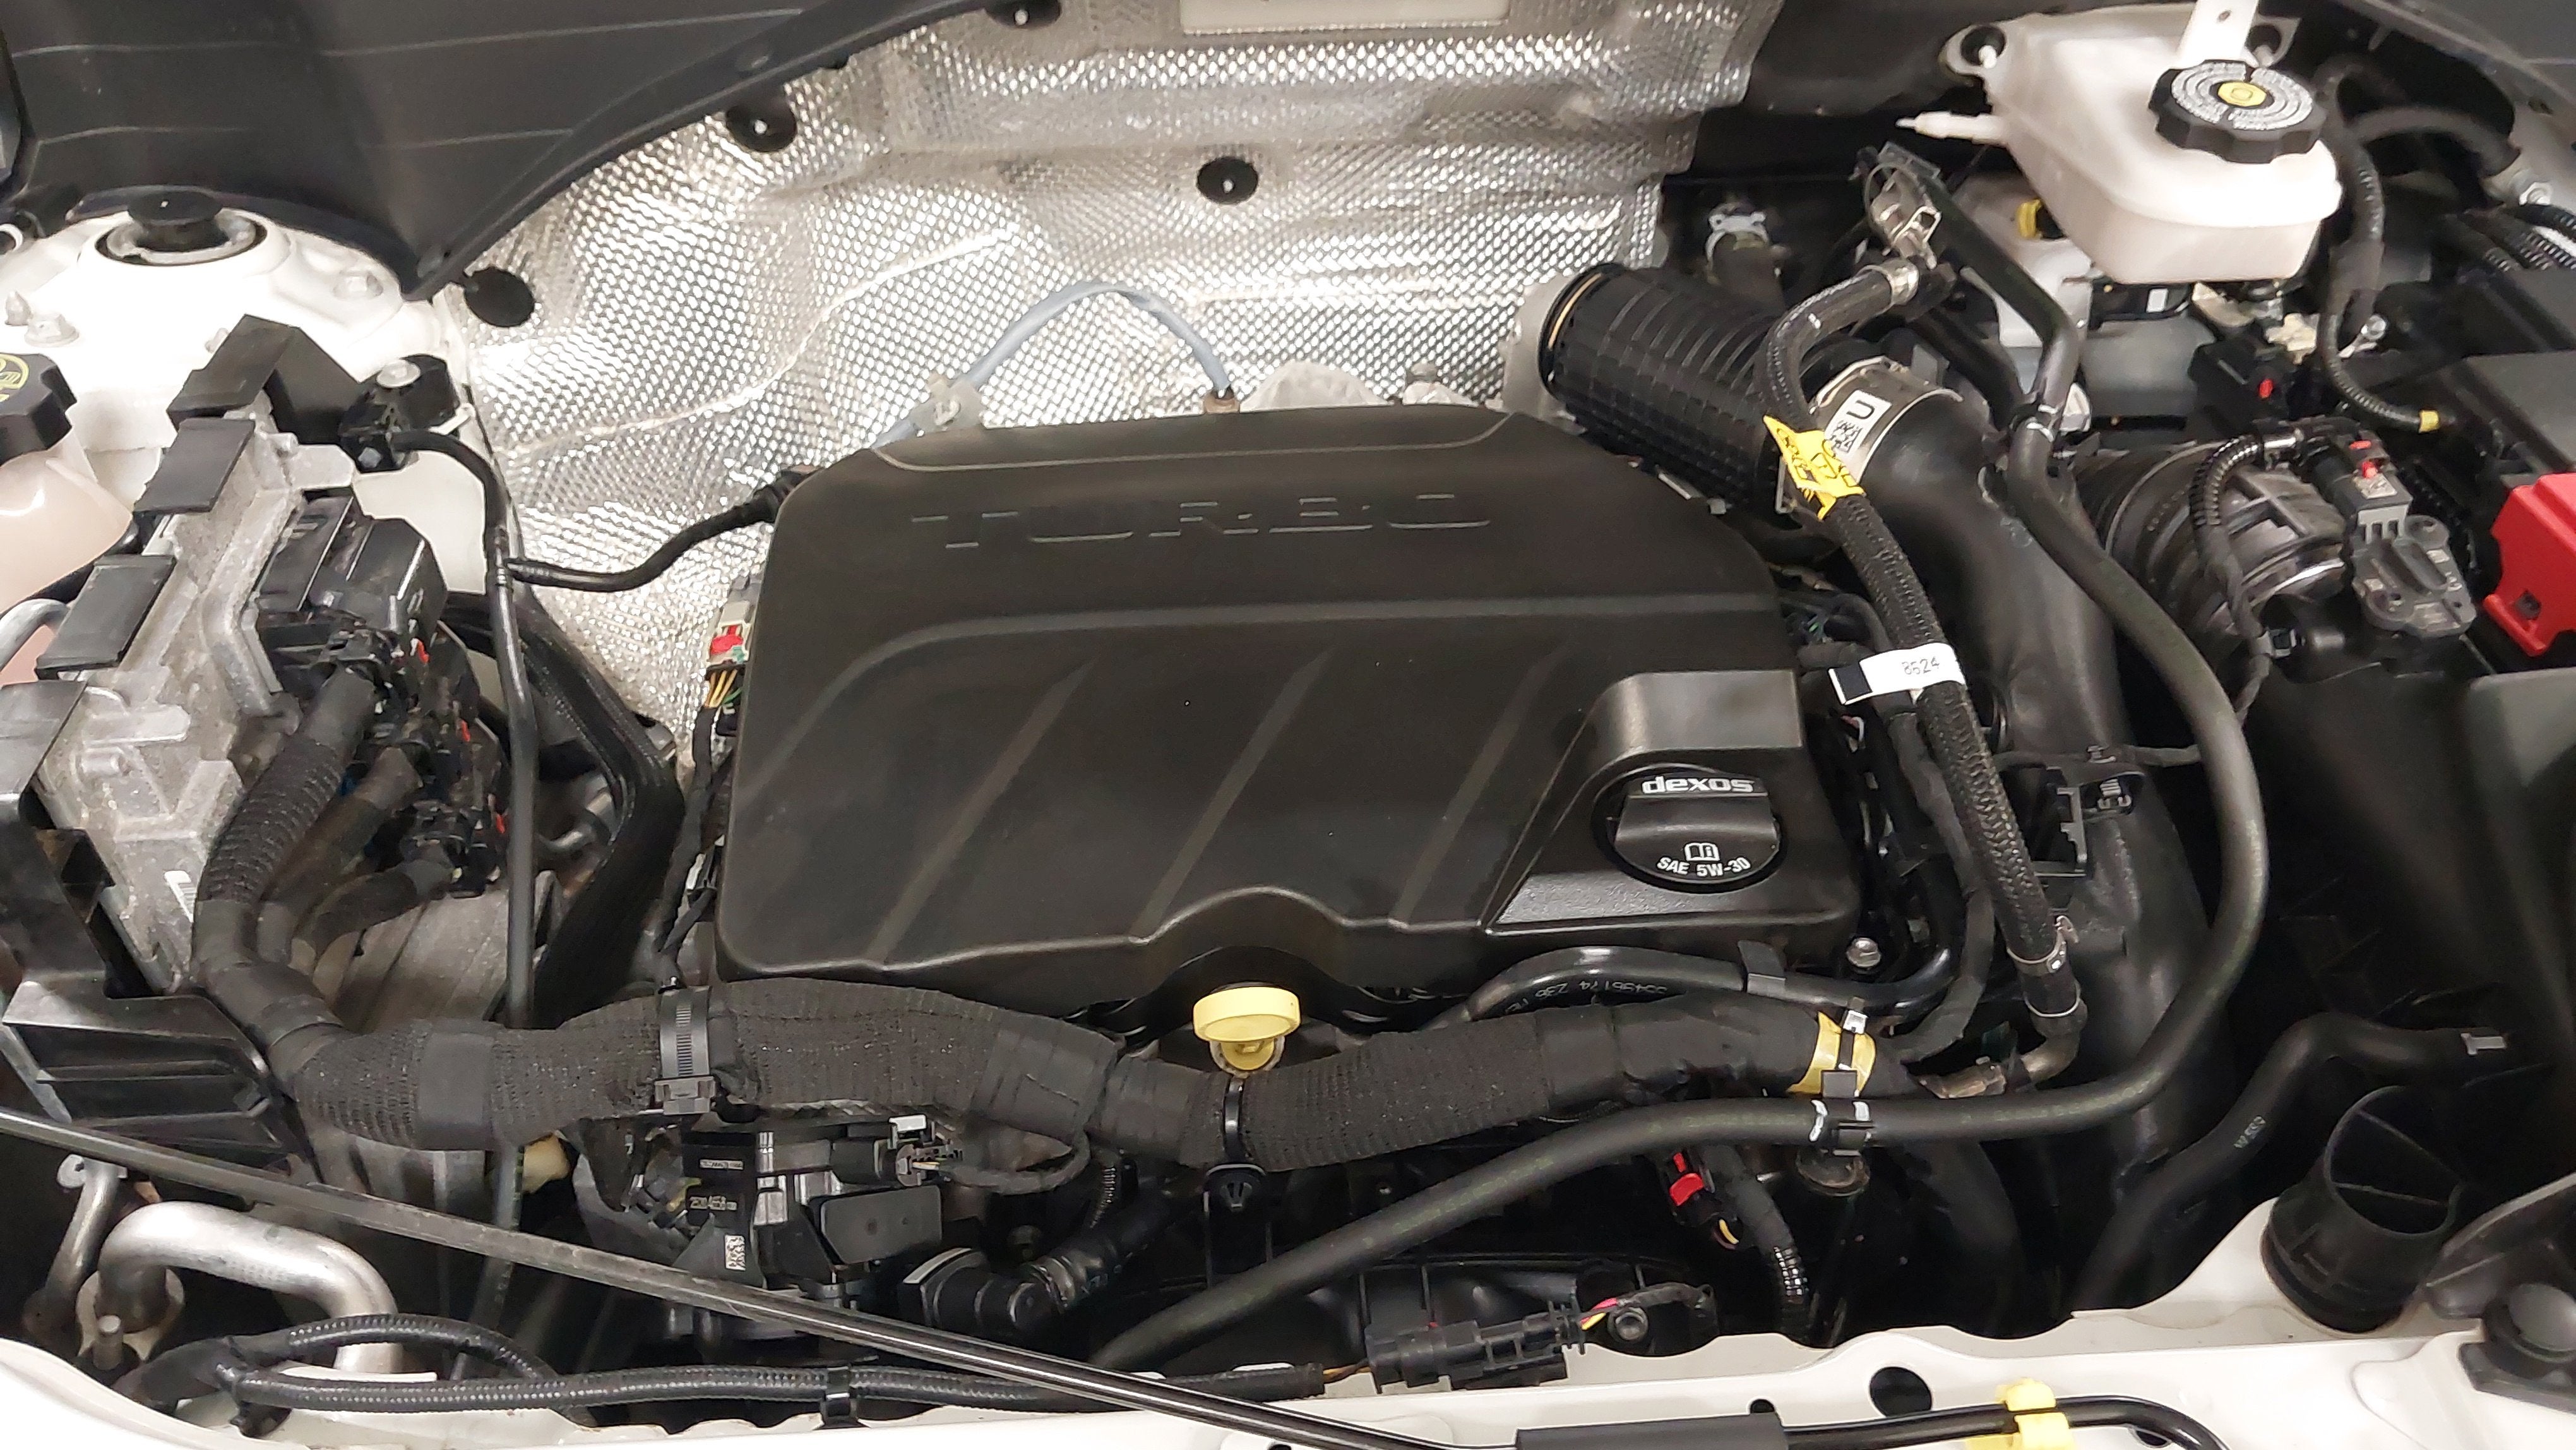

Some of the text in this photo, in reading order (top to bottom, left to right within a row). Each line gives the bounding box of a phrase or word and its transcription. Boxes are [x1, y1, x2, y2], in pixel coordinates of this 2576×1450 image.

[1846, 399, 1875, 420] U
[910, 488, 1492, 549] TURBO
[1901, 656, 1940, 675] 8524
[1642, 776, 1755, 794] dexos
[1657, 857, 1751, 877] SAE 5W-30
